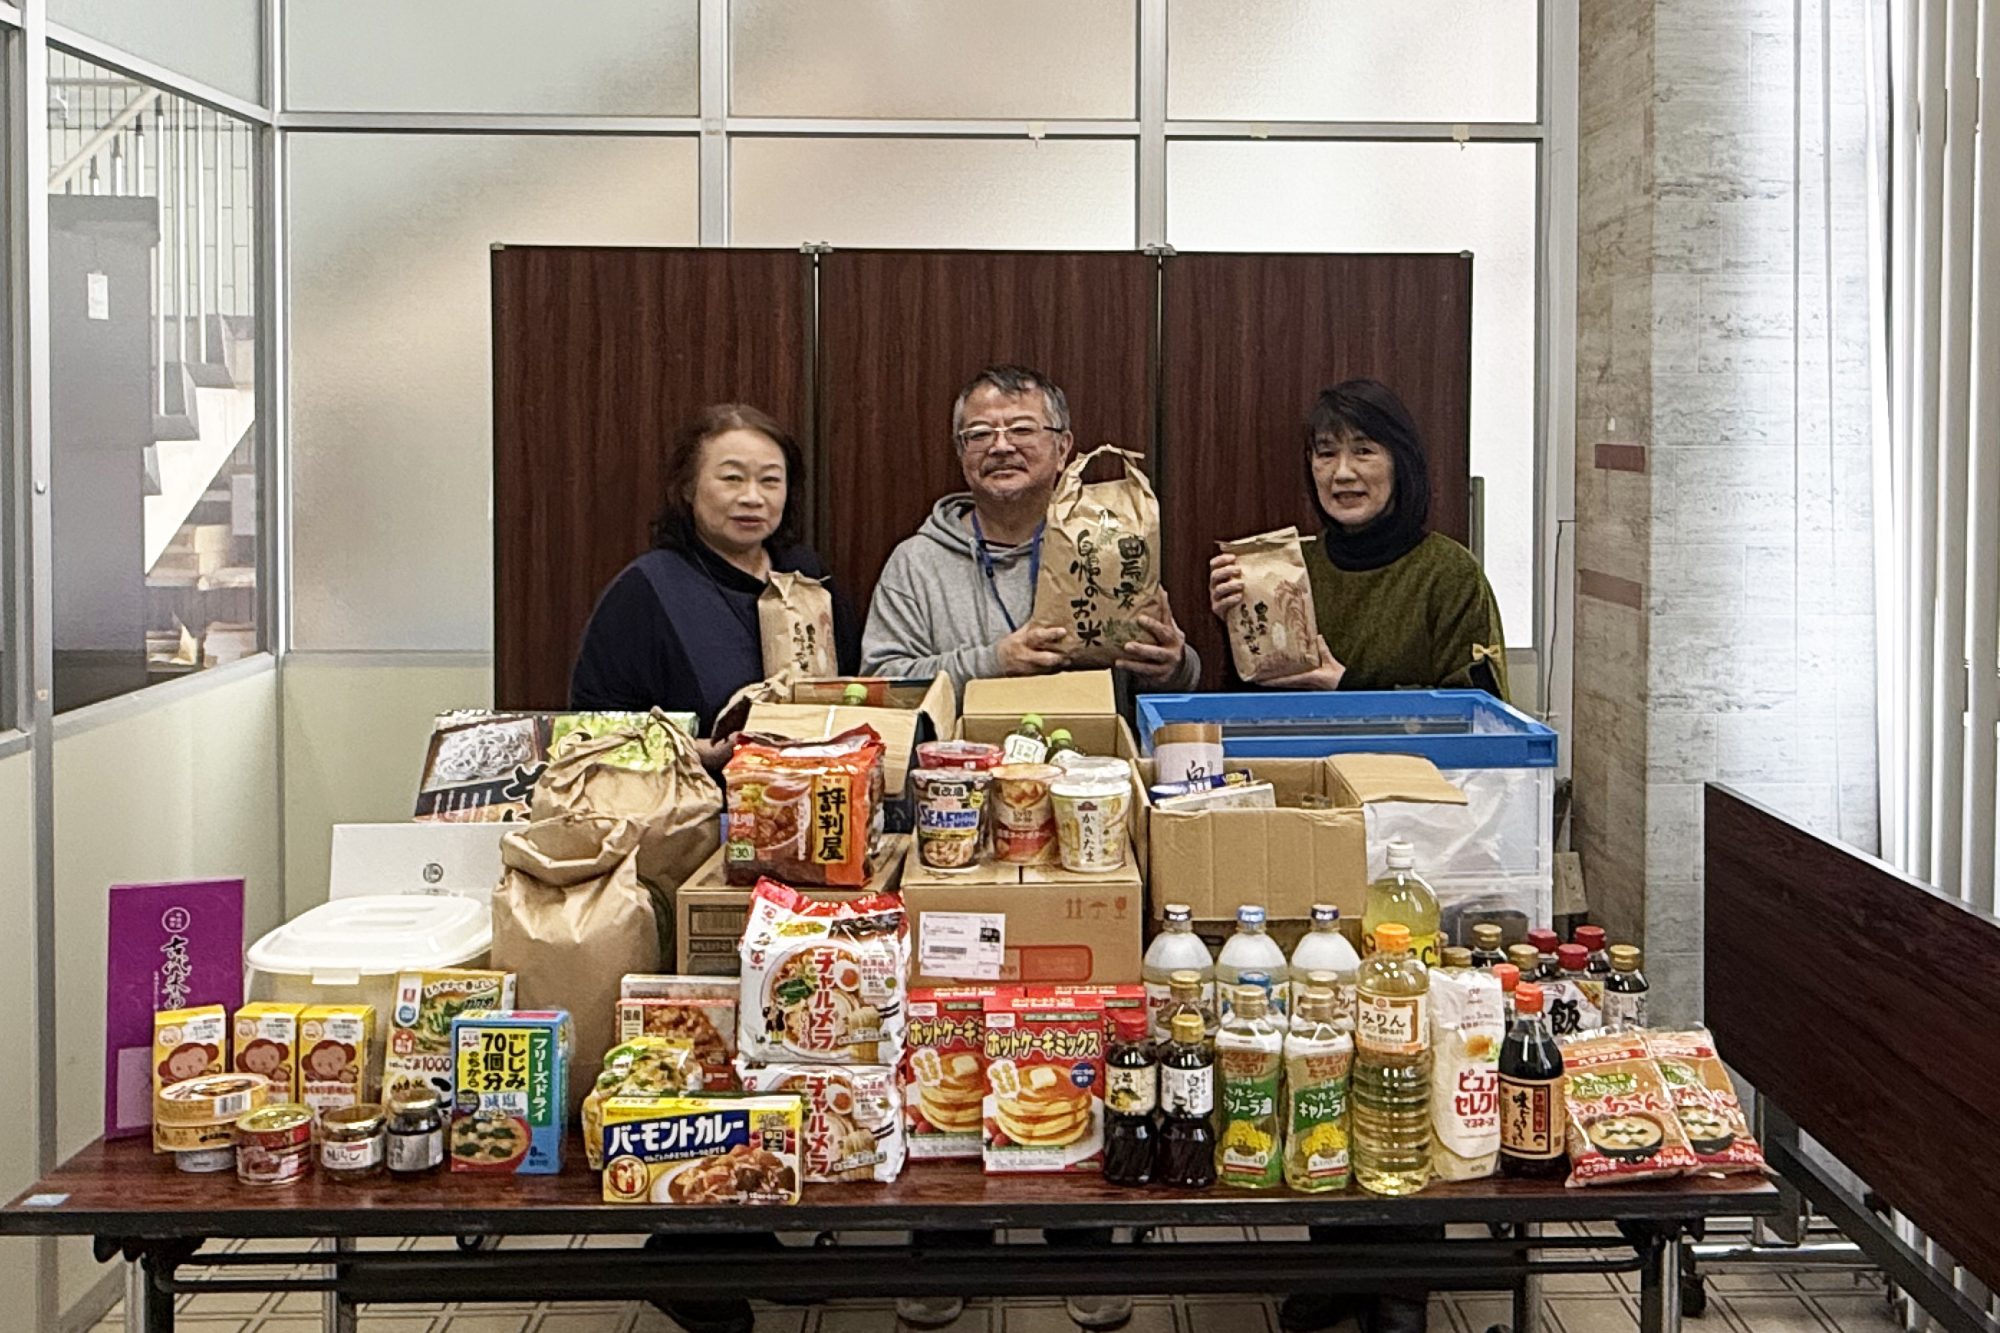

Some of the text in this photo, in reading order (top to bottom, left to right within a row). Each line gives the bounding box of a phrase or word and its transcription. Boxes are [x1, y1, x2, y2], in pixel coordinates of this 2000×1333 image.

[816, 785, 847, 861] 評判屋
[919, 804, 978, 829] SEAFOOD
[814, 950, 836, 1050] チャルメラ
[1362, 1010, 1406, 1028] みりん
[481, 1033, 507, 1091] 70個分
[505, 1041, 527, 1090] しじみ
[987, 1031, 1102, 1056] ホットケーキミックス
[467, 1051, 481, 1088] のちから
[533, 1038, 550, 1122] フリーズドライ
[608, 1113, 746, 1156] バーモントカレー
[807, 1076, 830, 1173] チャルメラ
